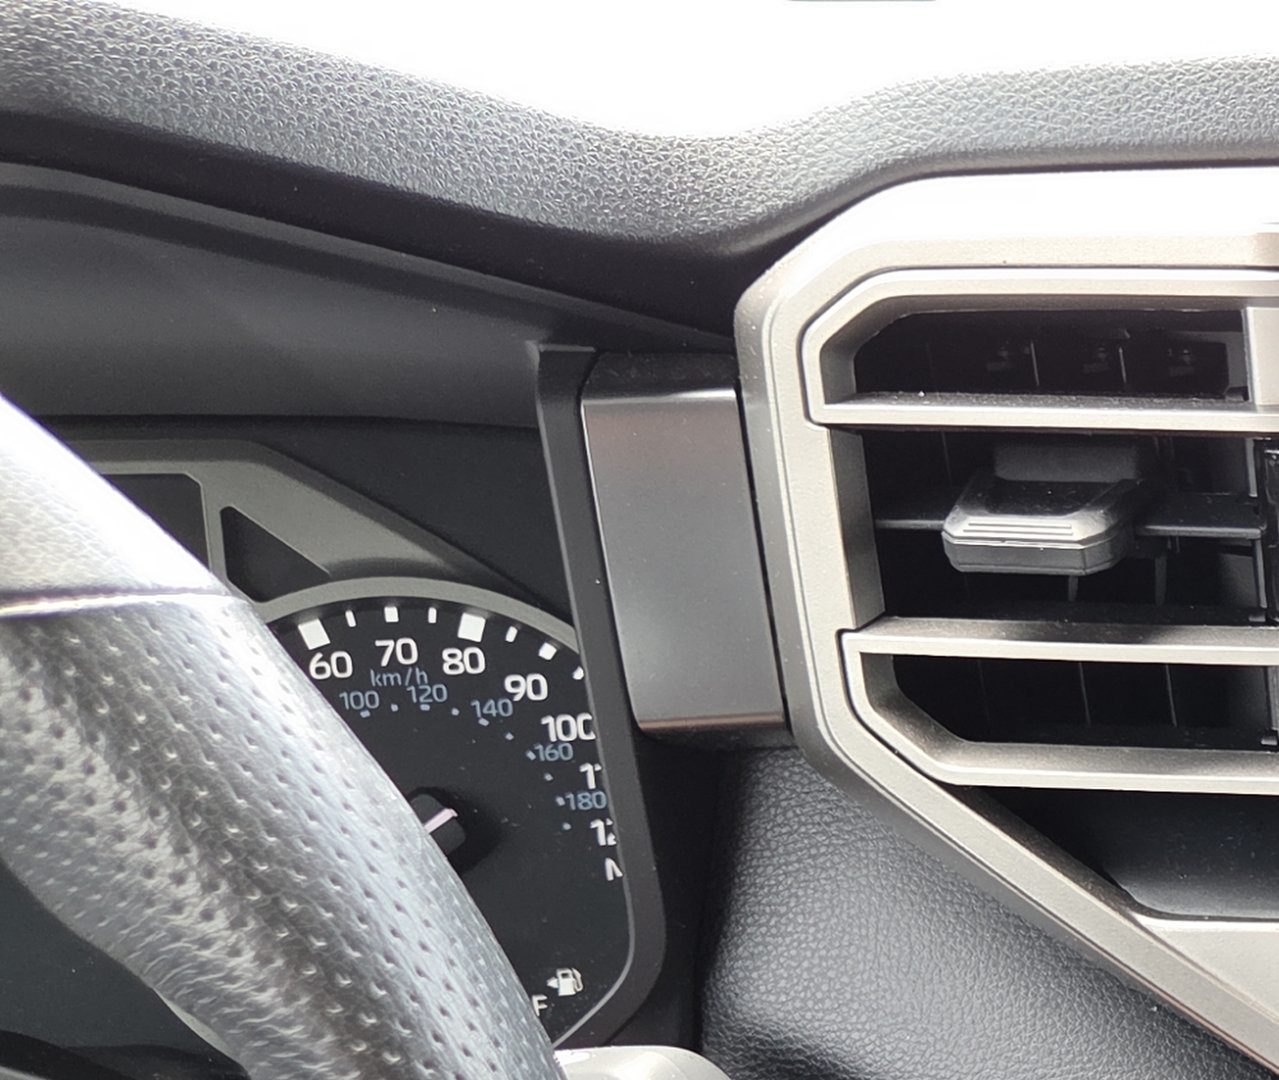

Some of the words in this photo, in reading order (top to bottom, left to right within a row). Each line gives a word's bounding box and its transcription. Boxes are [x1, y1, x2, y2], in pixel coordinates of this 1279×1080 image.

[374, 637, 419, 666] 70
[441, 647, 486, 676] 80
[308, 650, 353, 679] 60
[369, 667, 429, 689] km/h
[504, 673, 548, 701] 90
[338, 690, 380, 710] 100
[406, 683, 448, 703] 120
[471, 698, 513, 719] 140
[541, 711, 597, 742] 100
[534, 742, 574, 762] 160
[564, 790, 608, 811] 180
